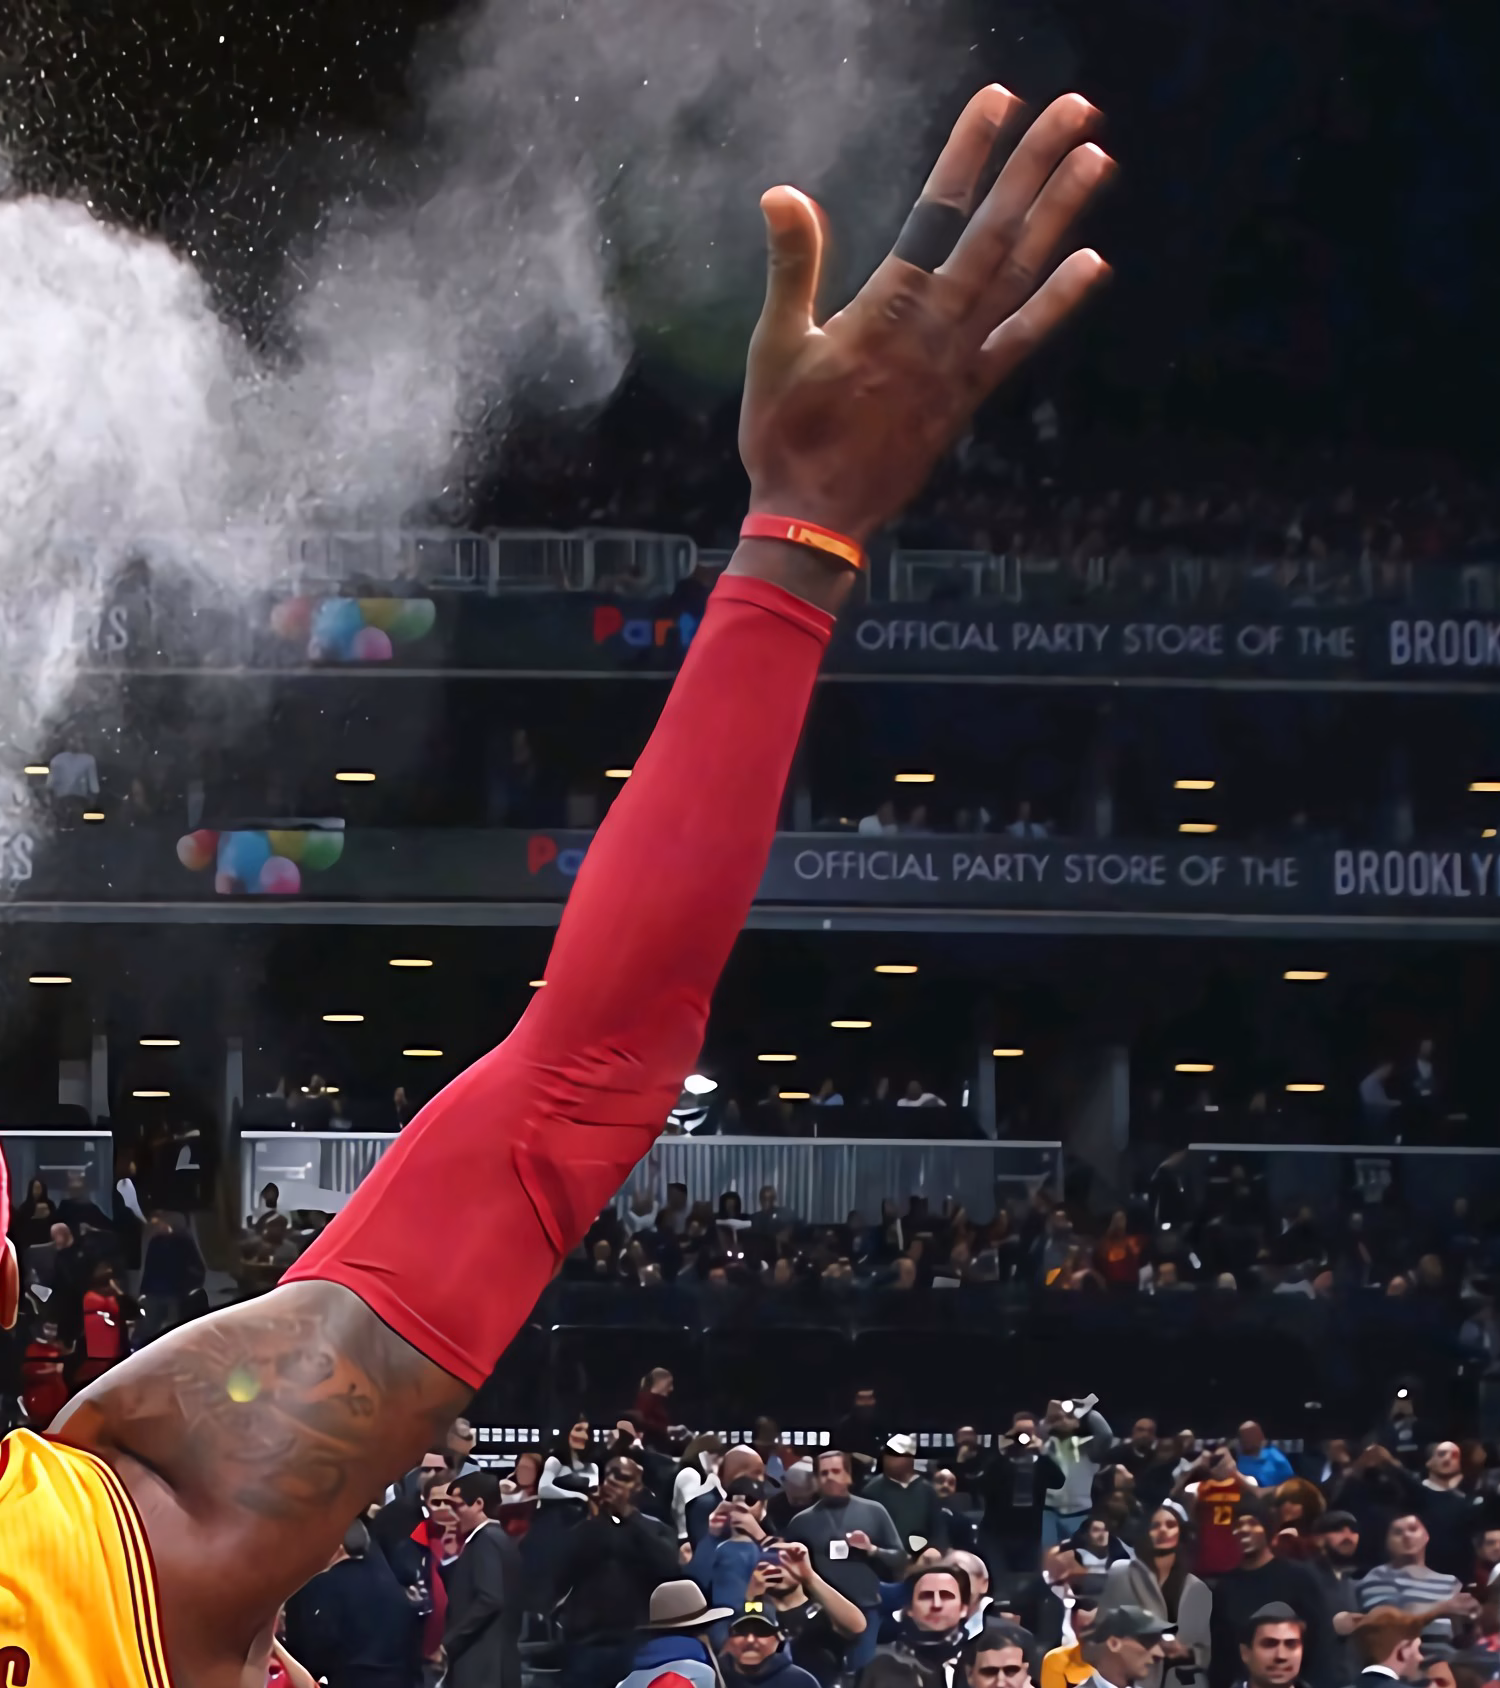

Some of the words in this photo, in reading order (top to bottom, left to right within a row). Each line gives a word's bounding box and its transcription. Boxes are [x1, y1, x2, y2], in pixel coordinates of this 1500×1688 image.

[856, 620, 998, 653] OFFICIAL
[1012, 624, 1109, 655] PARTY
[1124, 625, 1224, 656] STORE
[1237, 626, 1285, 657] OF
[1297, 625, 1355, 657] THE
[795, 850, 939, 882] OFFICIAL
[953, 853, 1050, 884] PARTY
[1064, 855, 1166, 886] STORE
[1179, 856, 1226, 887] OF
[1240, 857, 1299, 887] THE
